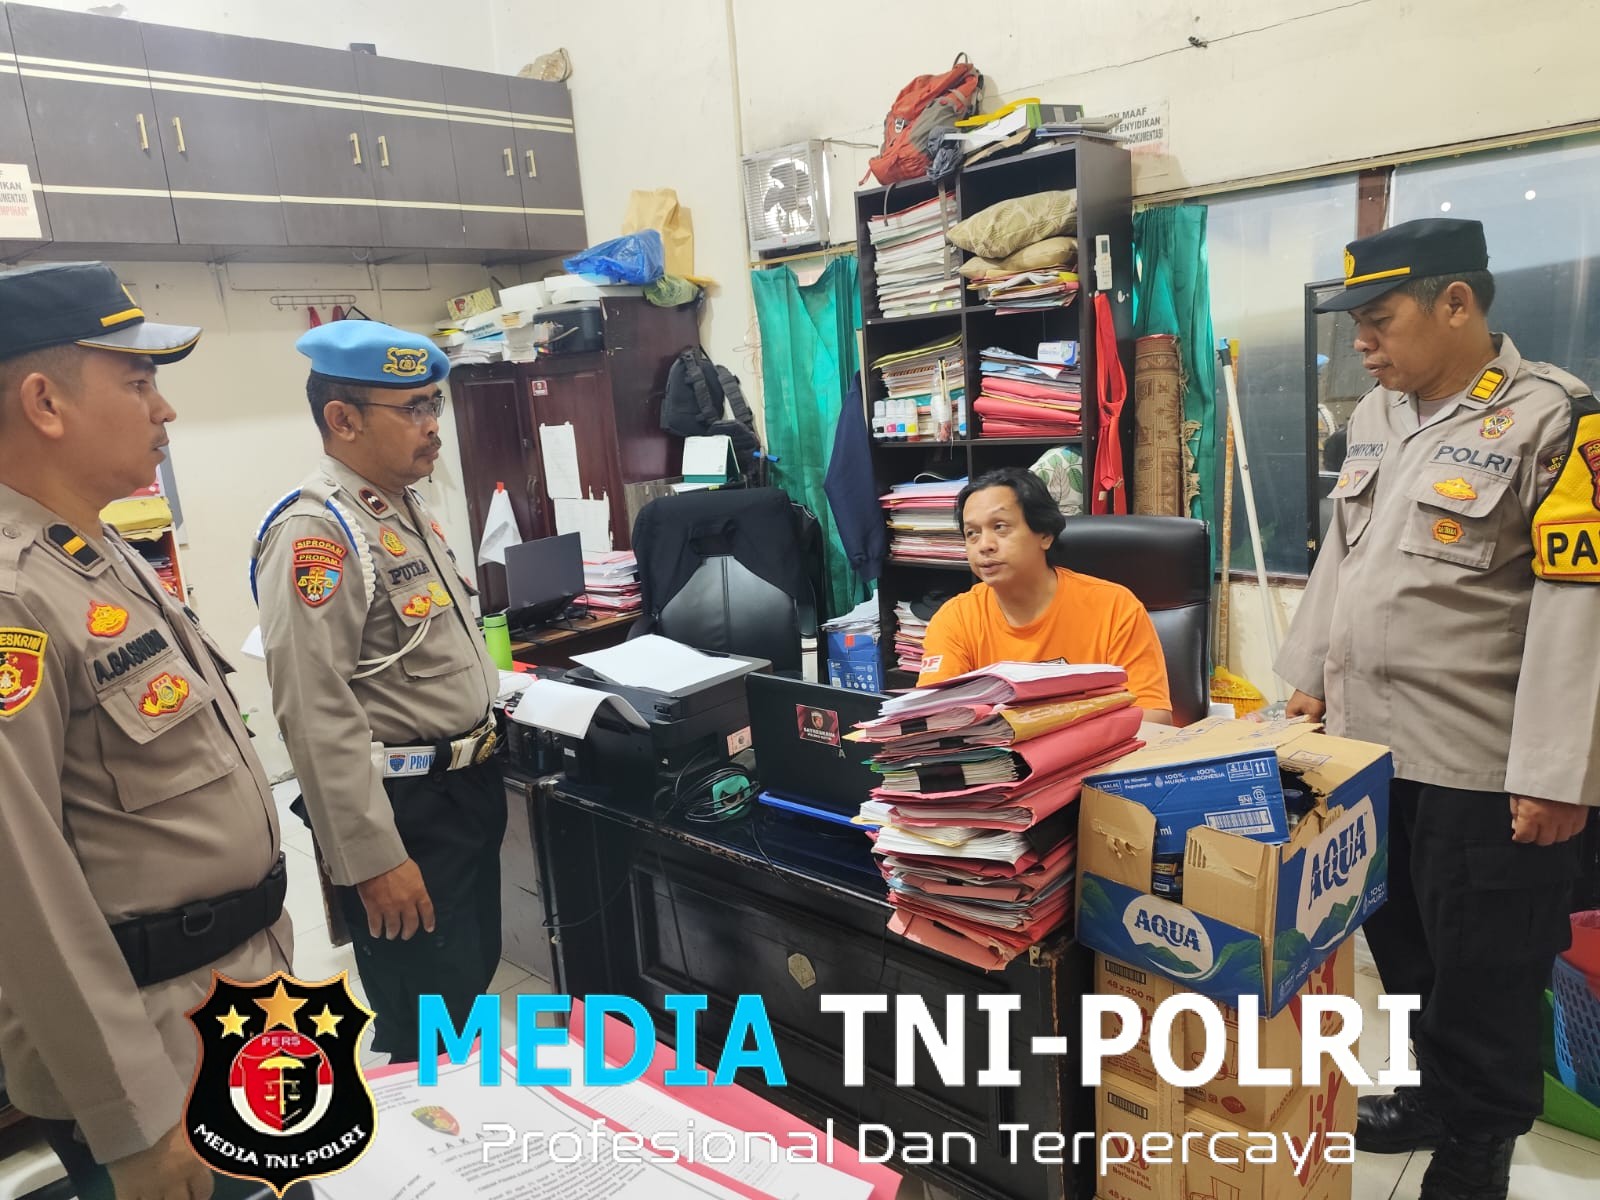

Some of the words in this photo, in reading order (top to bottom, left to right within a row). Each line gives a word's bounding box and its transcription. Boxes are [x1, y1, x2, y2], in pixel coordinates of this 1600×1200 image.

[1122, 107, 1147, 119] MAAF
[1434, 445, 1513, 474] POLRI
[1547, 530, 1600, 567] PA
[299, 554, 338, 565] PROPAM
[1159, 826, 1173, 837] ml
[1308, 813, 1368, 911] AQUA
[1134, 909, 1201, 952] AQUA
[1126, 986, 1144, 999] 200
